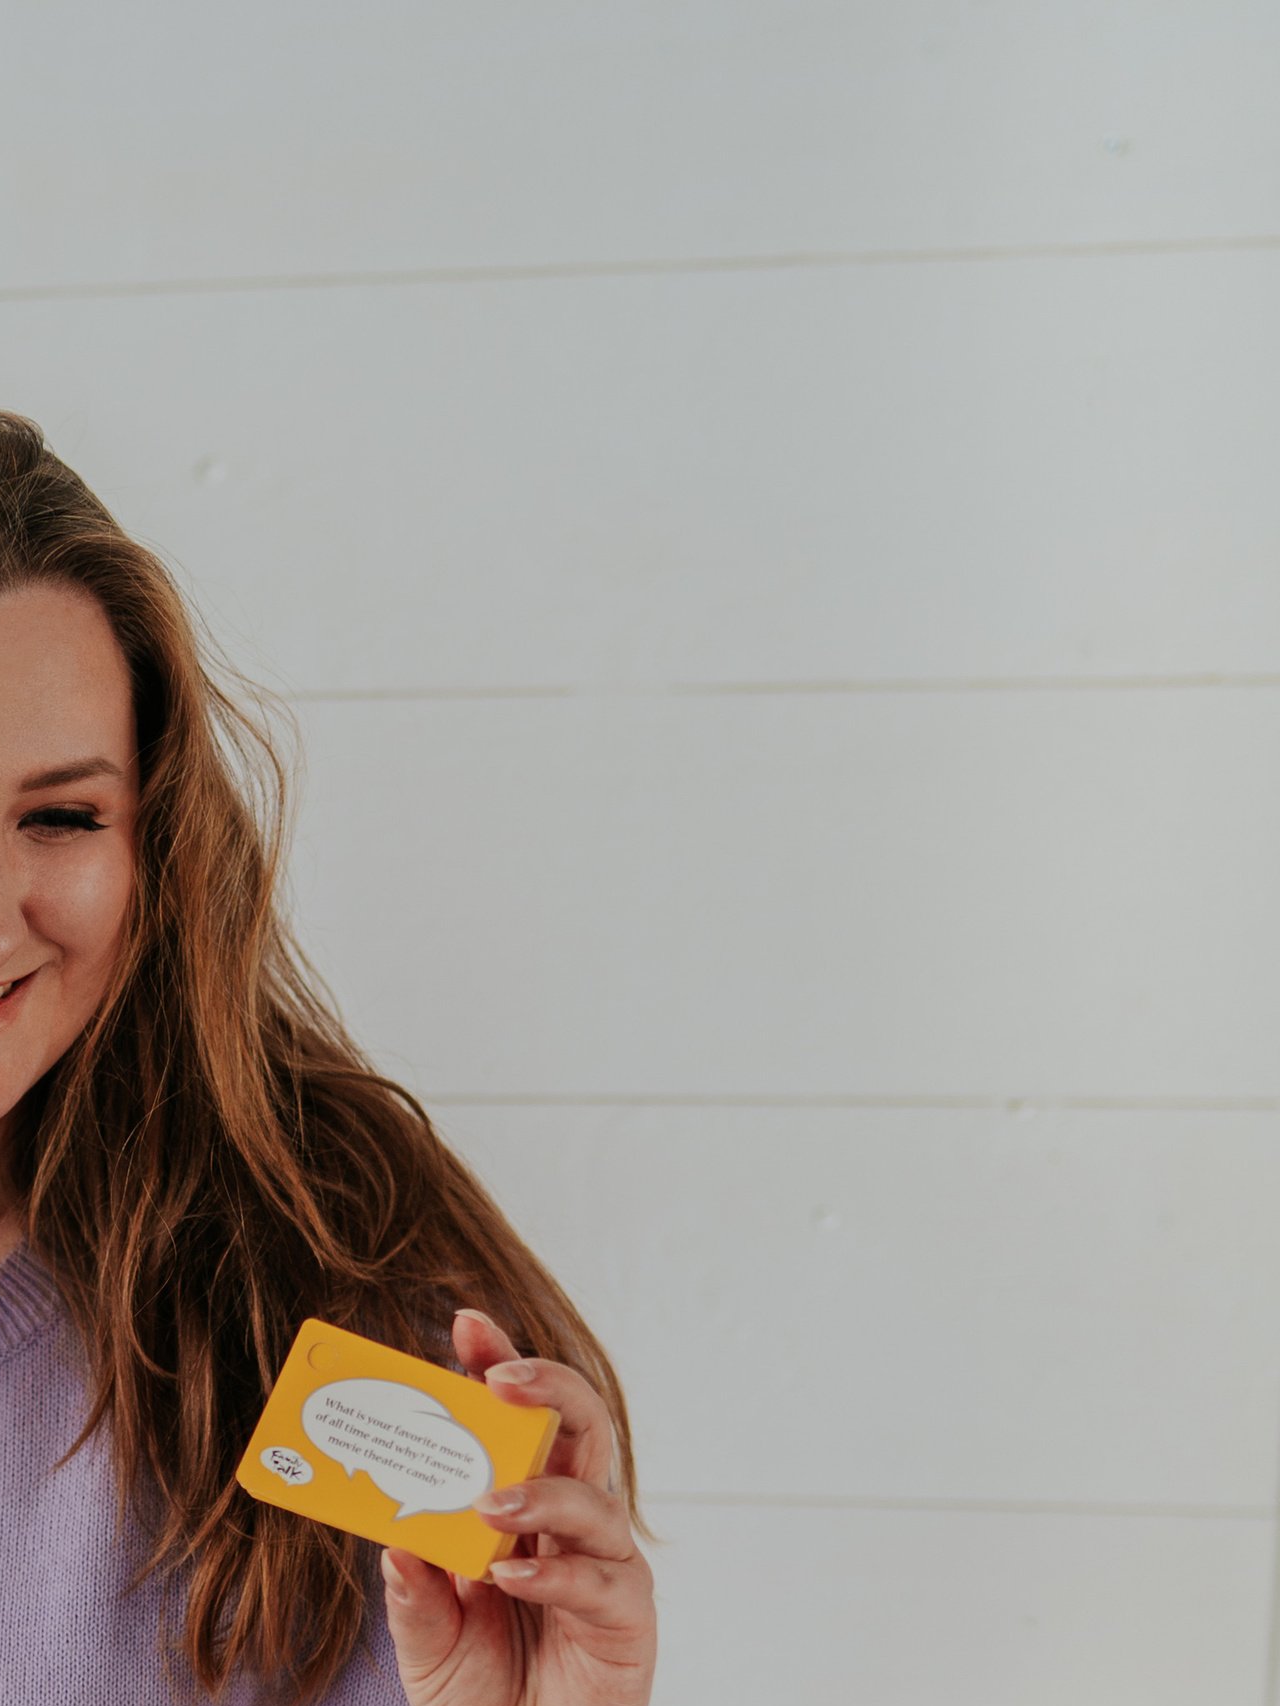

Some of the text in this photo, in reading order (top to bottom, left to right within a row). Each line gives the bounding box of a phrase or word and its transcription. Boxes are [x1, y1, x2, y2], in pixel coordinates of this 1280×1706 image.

[315, 1413, 470, 1480] of all time and why? Favorite
[325, 1397, 474, 1464] What is your favorite movie
[328, 1435, 446, 1486] movie theater candy?
